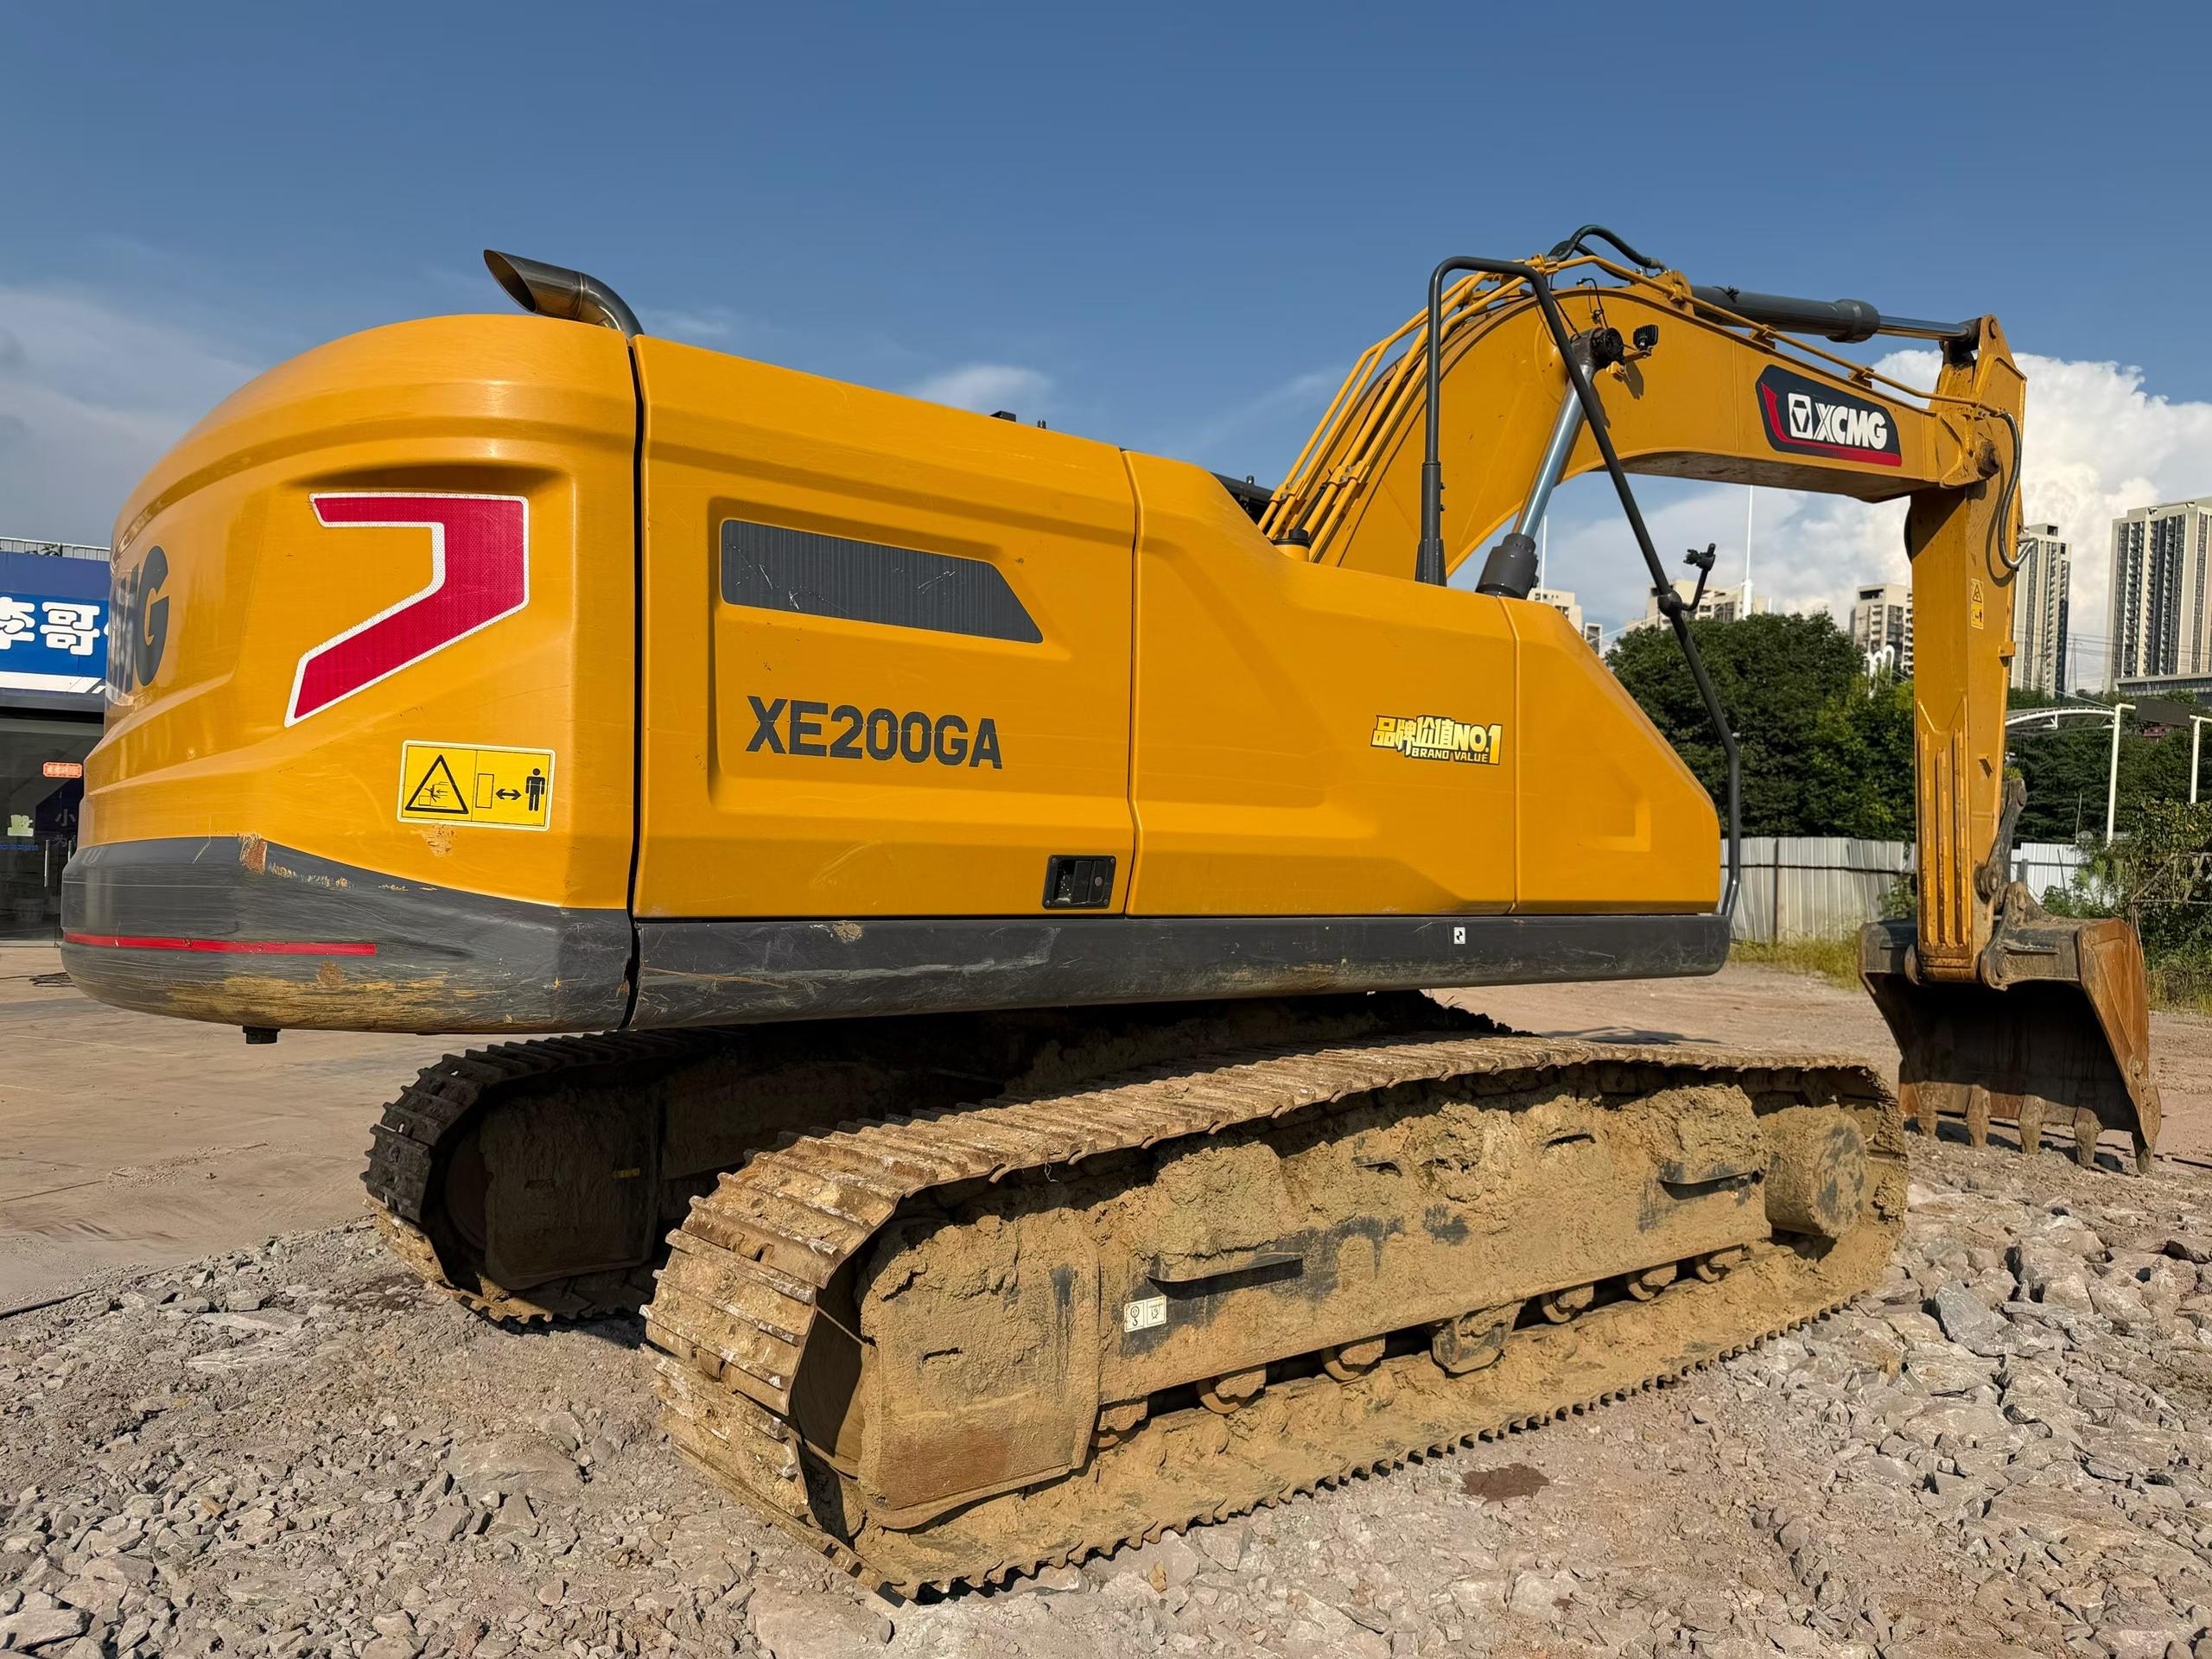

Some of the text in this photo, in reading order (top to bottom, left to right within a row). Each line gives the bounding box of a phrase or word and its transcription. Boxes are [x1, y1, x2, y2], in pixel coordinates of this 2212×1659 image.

[1814, 403, 1887, 449] XCMG
[0, 596, 109, 656] 李哥
[746, 695, 1002, 769] XE200GA
[1411, 747, 1488, 762] BRAND VALUE
